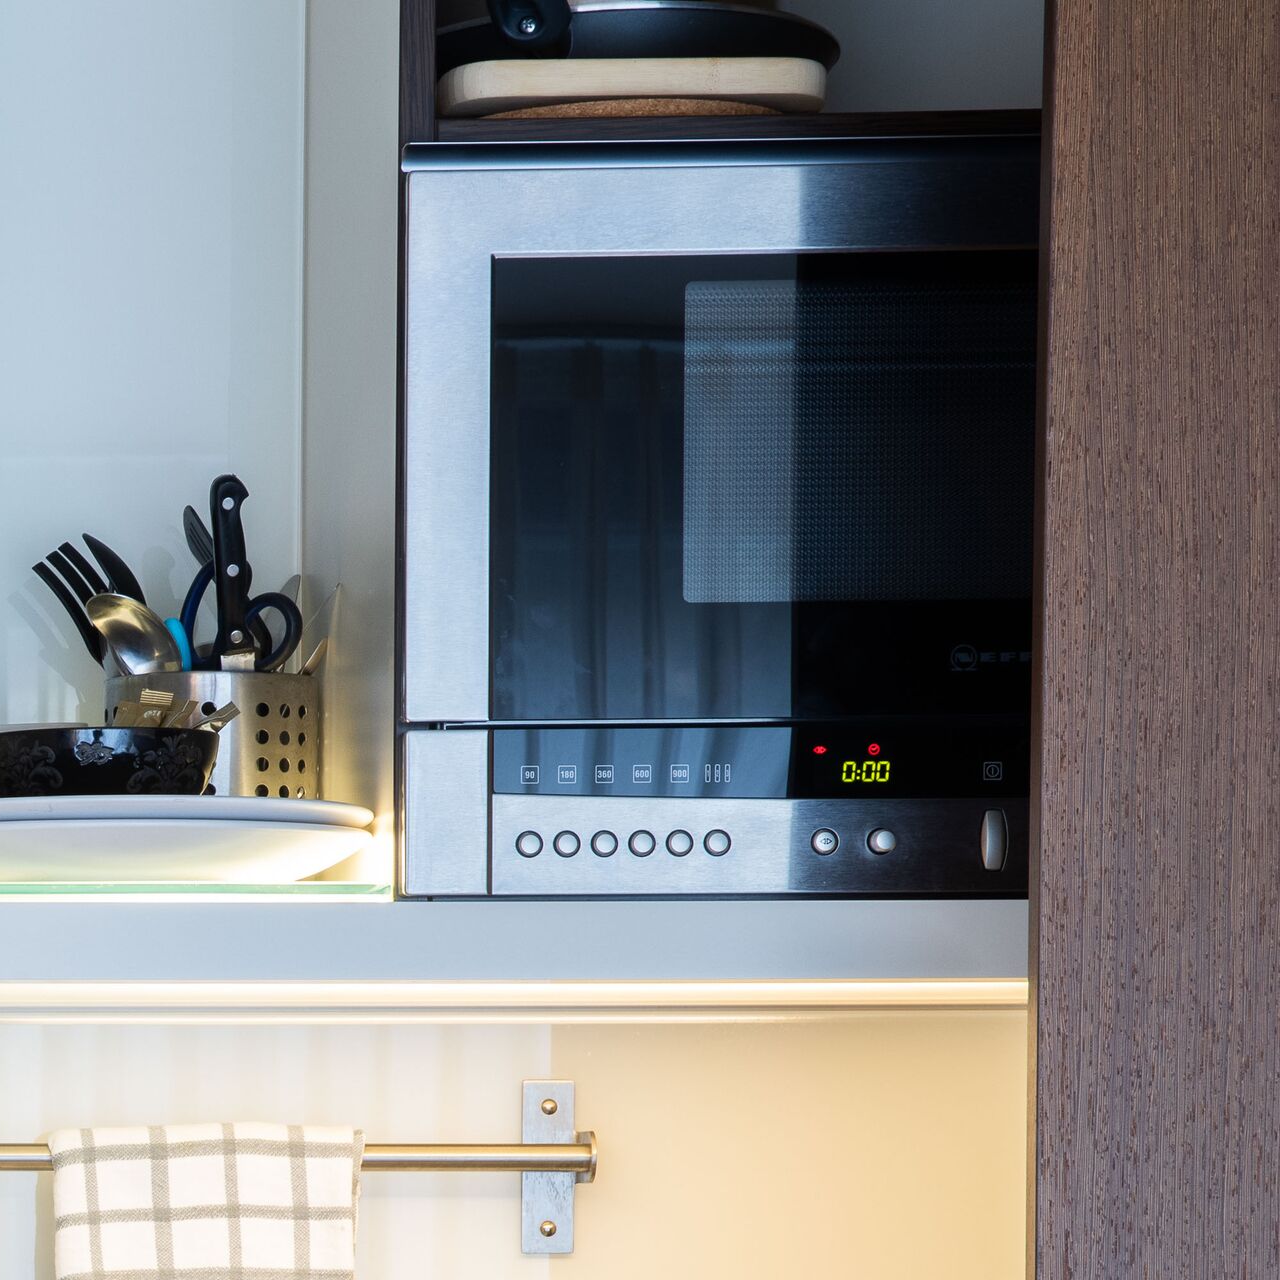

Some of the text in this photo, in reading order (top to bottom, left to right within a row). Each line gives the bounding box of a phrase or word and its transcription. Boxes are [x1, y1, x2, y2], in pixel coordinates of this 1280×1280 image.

[524, 769, 688, 779] 90 180 360 600 900
[842, 761, 890, 782] 0:00
